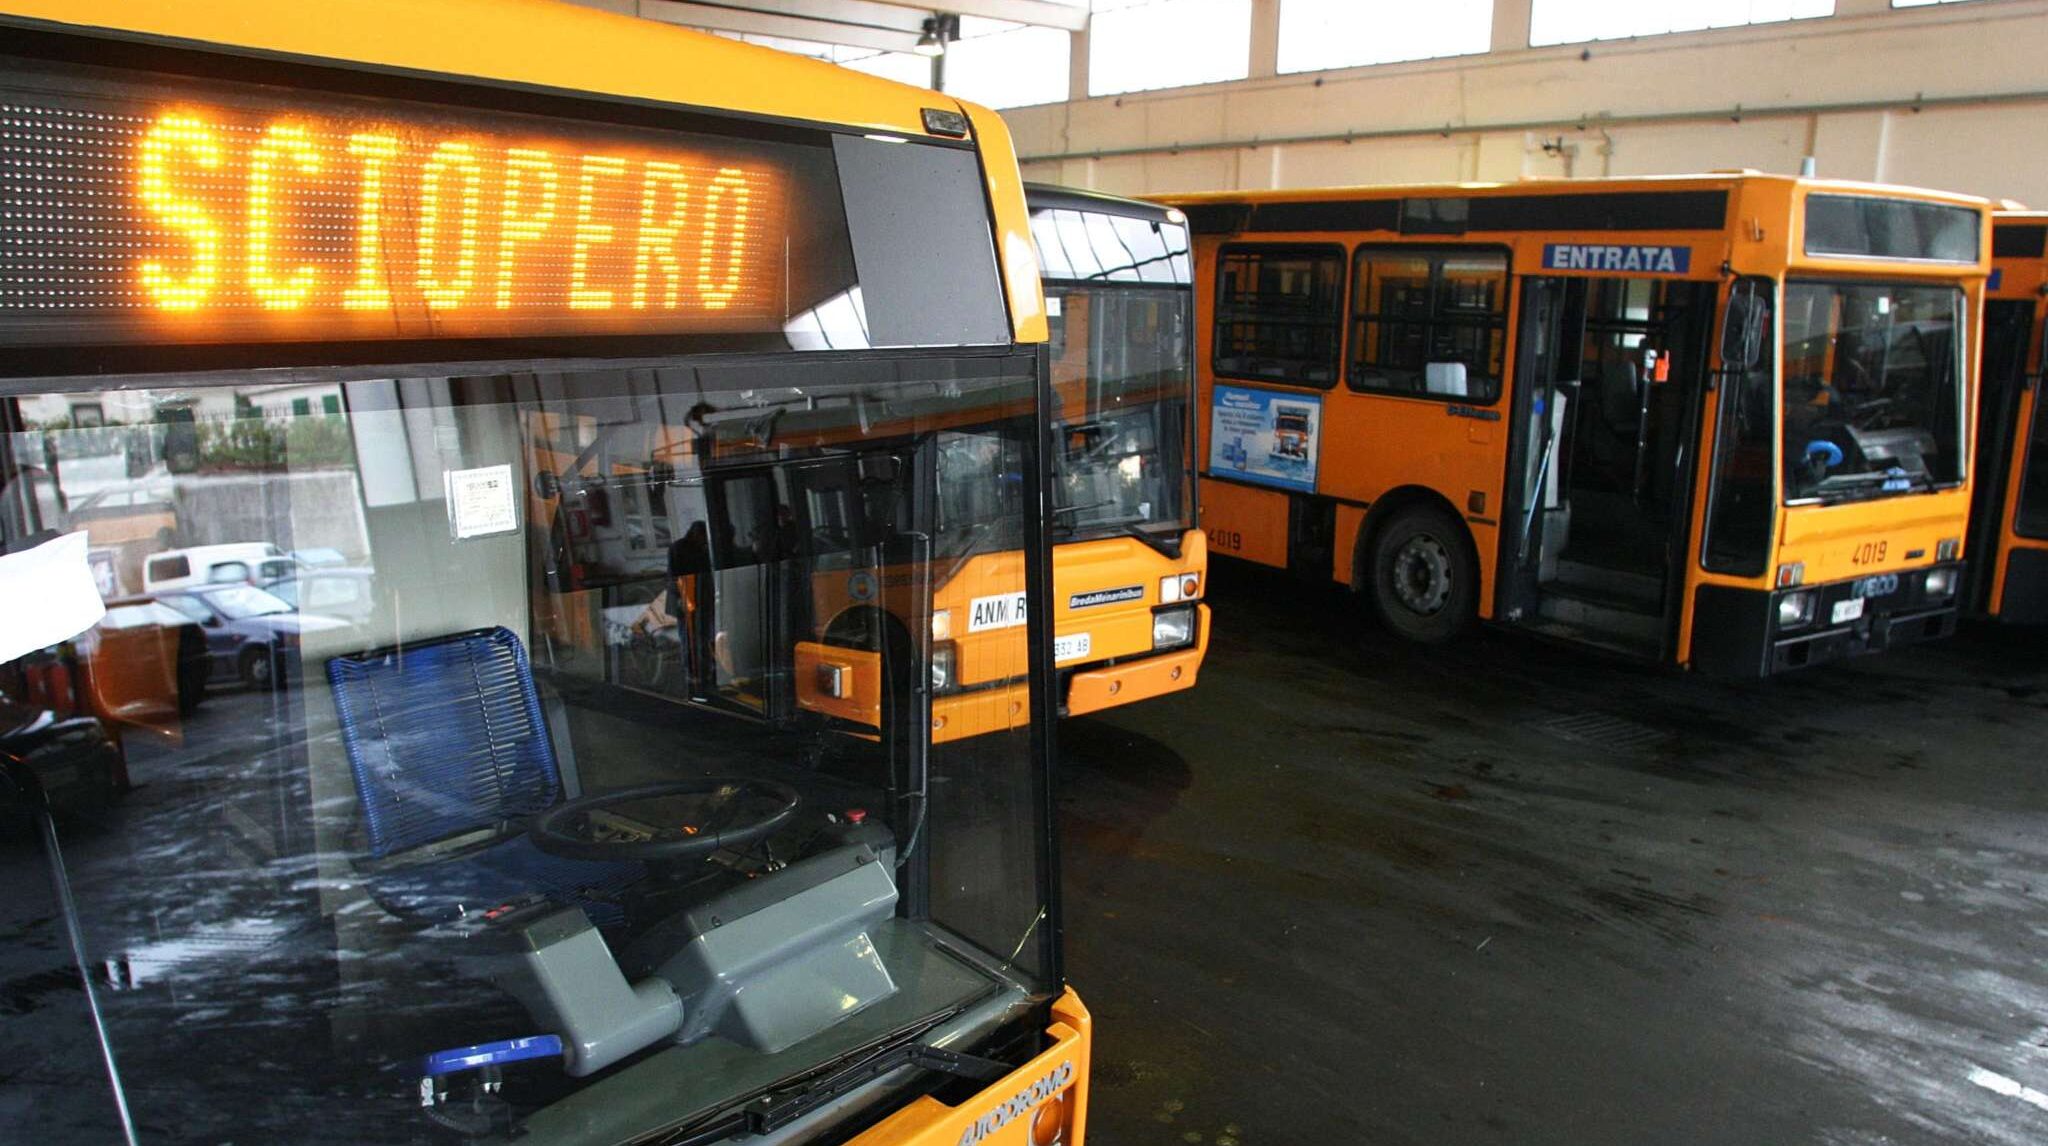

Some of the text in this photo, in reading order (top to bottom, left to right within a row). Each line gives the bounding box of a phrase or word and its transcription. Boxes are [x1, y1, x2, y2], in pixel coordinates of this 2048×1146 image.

[139, 111, 750, 311] SCIOPERO
[1552, 245, 1676, 272] ENTRATA
[1208, 529, 1241, 551] 4019
[1852, 540, 1888, 566] 4019
[1852, 574, 1898, 599] IVECO
[957, 1060, 1073, 1146] AUTODROMO
